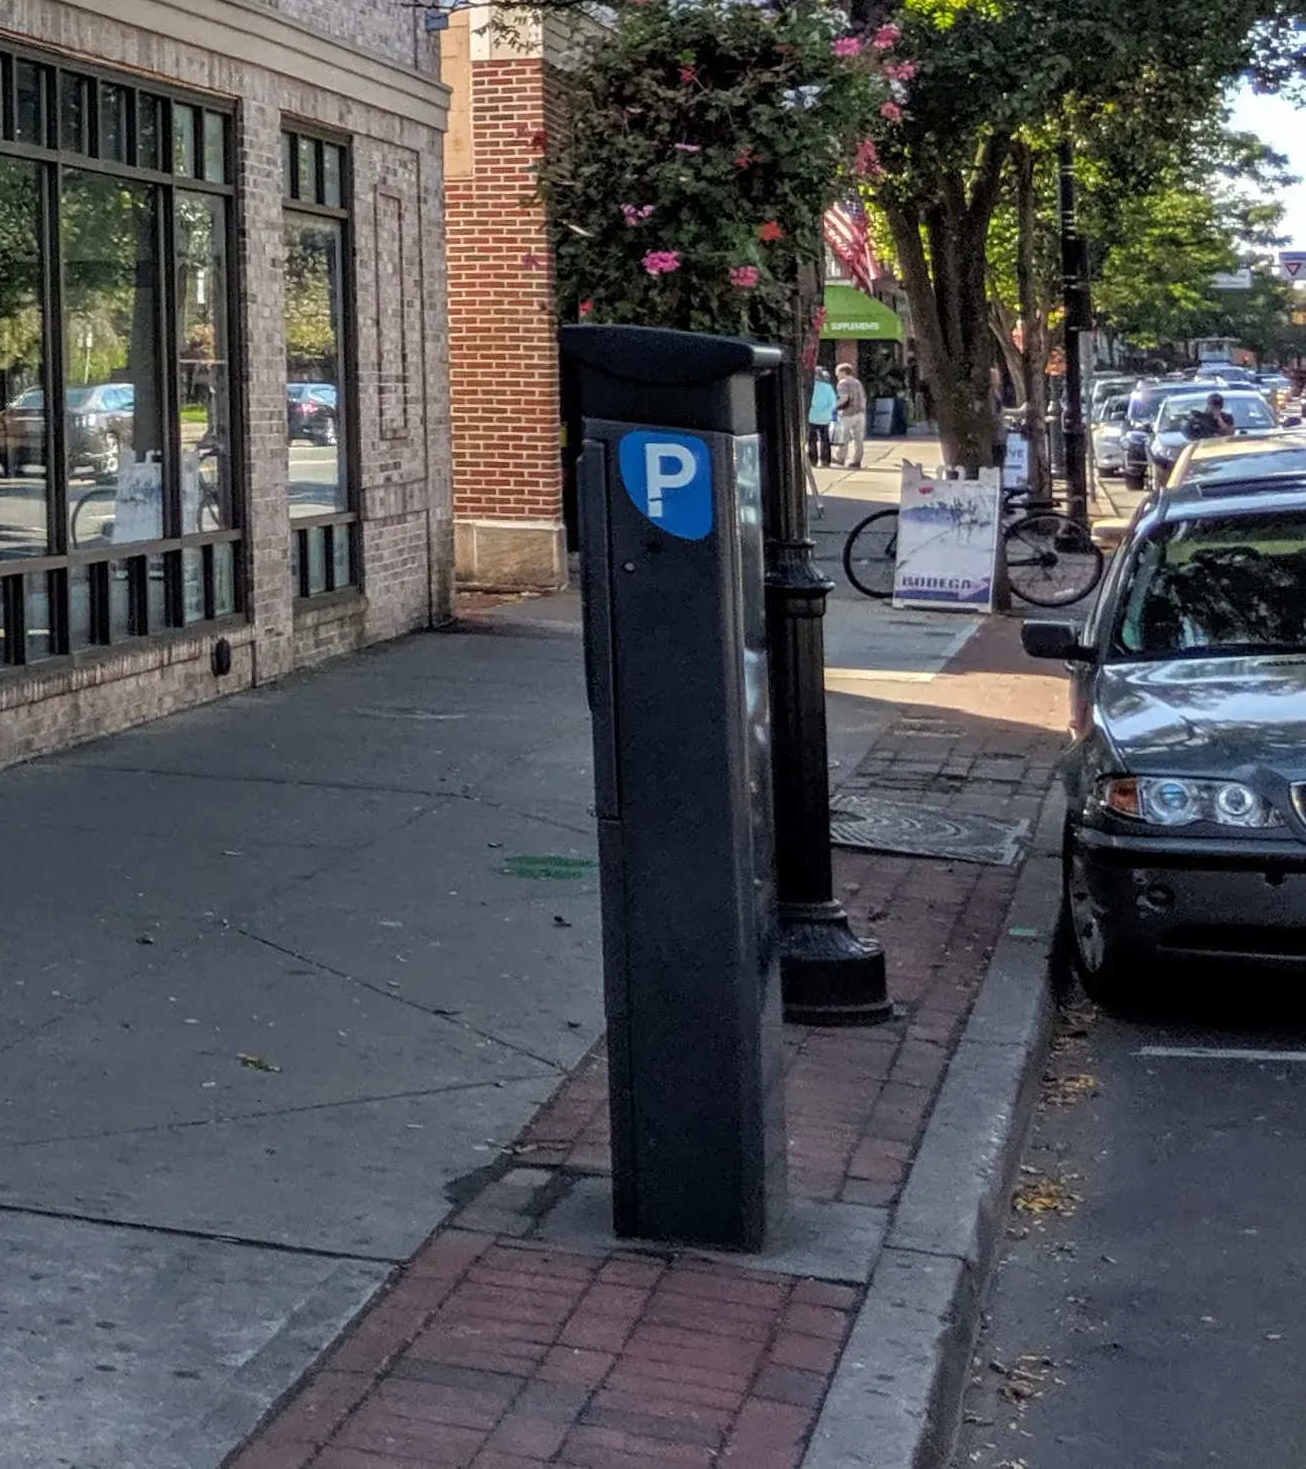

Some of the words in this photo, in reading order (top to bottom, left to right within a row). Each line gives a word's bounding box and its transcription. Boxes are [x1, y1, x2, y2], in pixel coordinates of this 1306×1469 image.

[830, 321, 880, 331] SUPPLEMENTS
[645, 443, 697, 518] P
[902, 576, 972, 589] BODEGA
